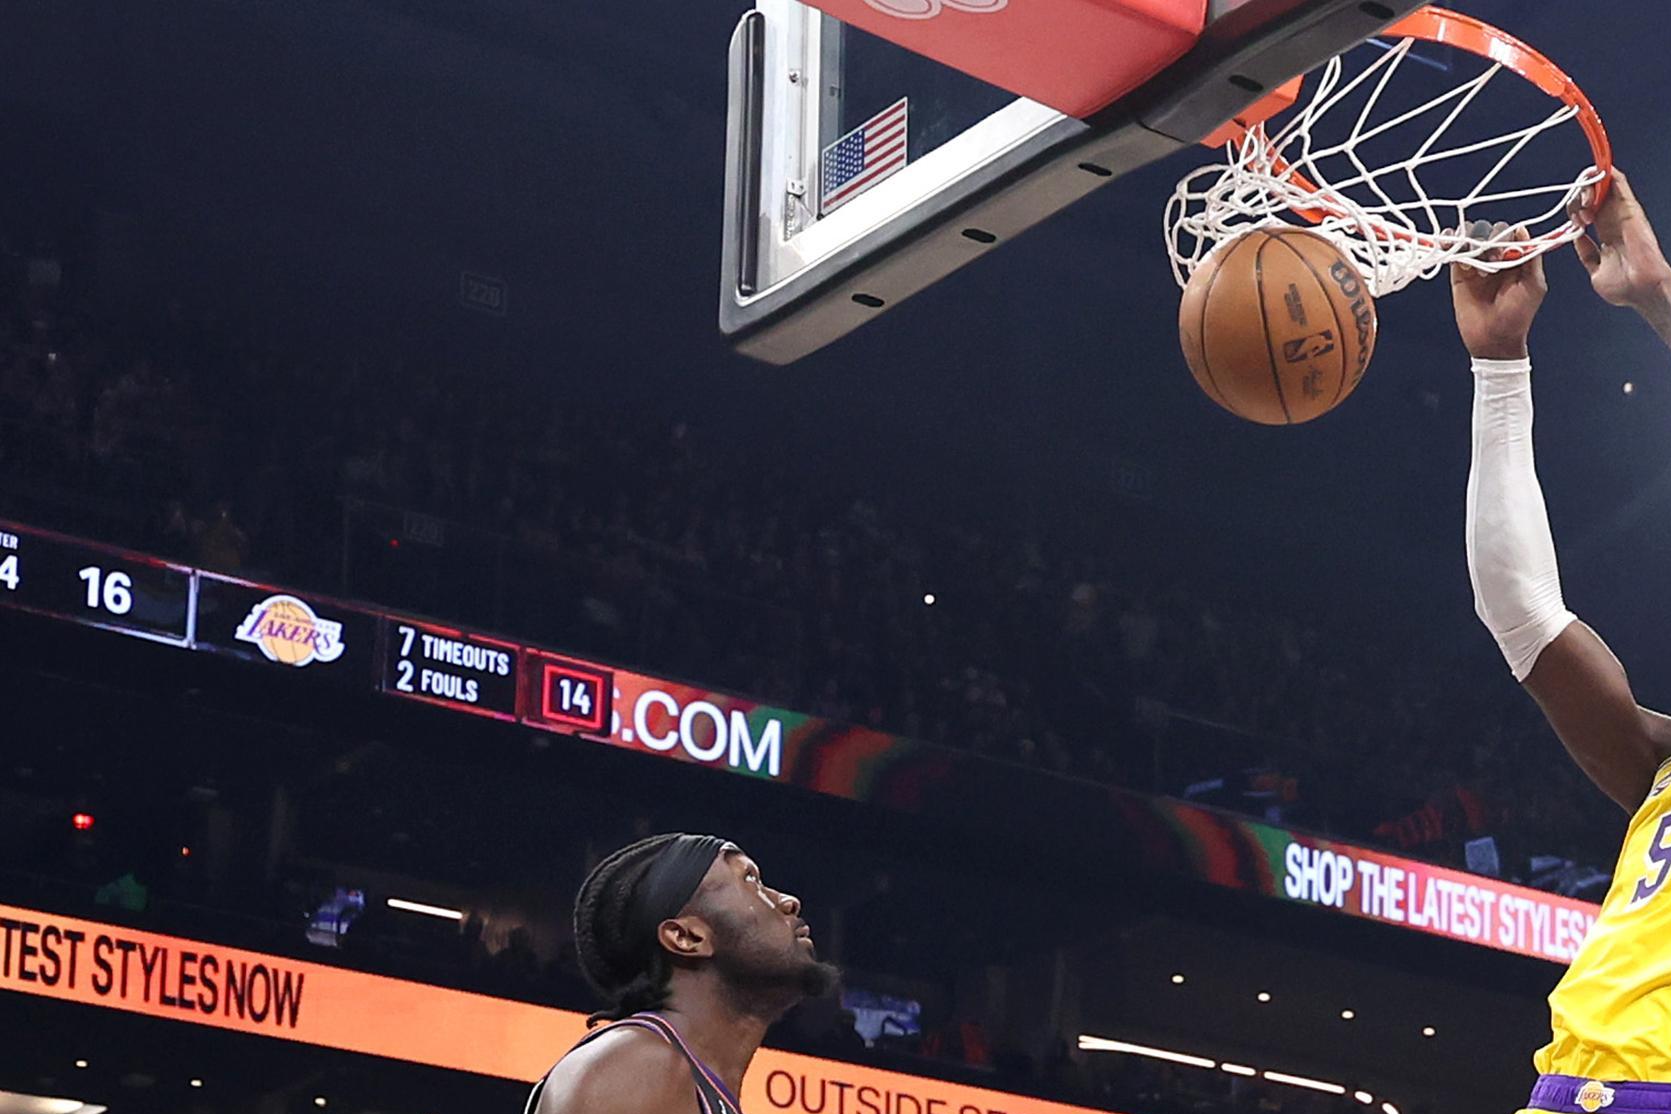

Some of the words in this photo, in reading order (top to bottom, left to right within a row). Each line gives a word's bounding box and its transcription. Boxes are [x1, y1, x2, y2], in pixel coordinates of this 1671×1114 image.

[79, 567, 132, 614] 16
[246, 608, 334, 657] LAKERS
[399, 627, 415, 657] 7
[422, 634, 509, 675] TIMEOUTS
[397, 661, 414, 692] 2
[421, 669, 478, 703] FOULS
[560, 679, 591, 715] 14
[1284, 842, 1353, 908] SHOP
[1357, 859, 1404, 922] THE
[1408, 872, 1498, 941] LATEST
[1498, 895, 1585, 959] STYLES
[0, 917, 85, 989] TEST
[92, 935, 219, 1014] STYLES
[224, 960, 304, 1028] NOW
